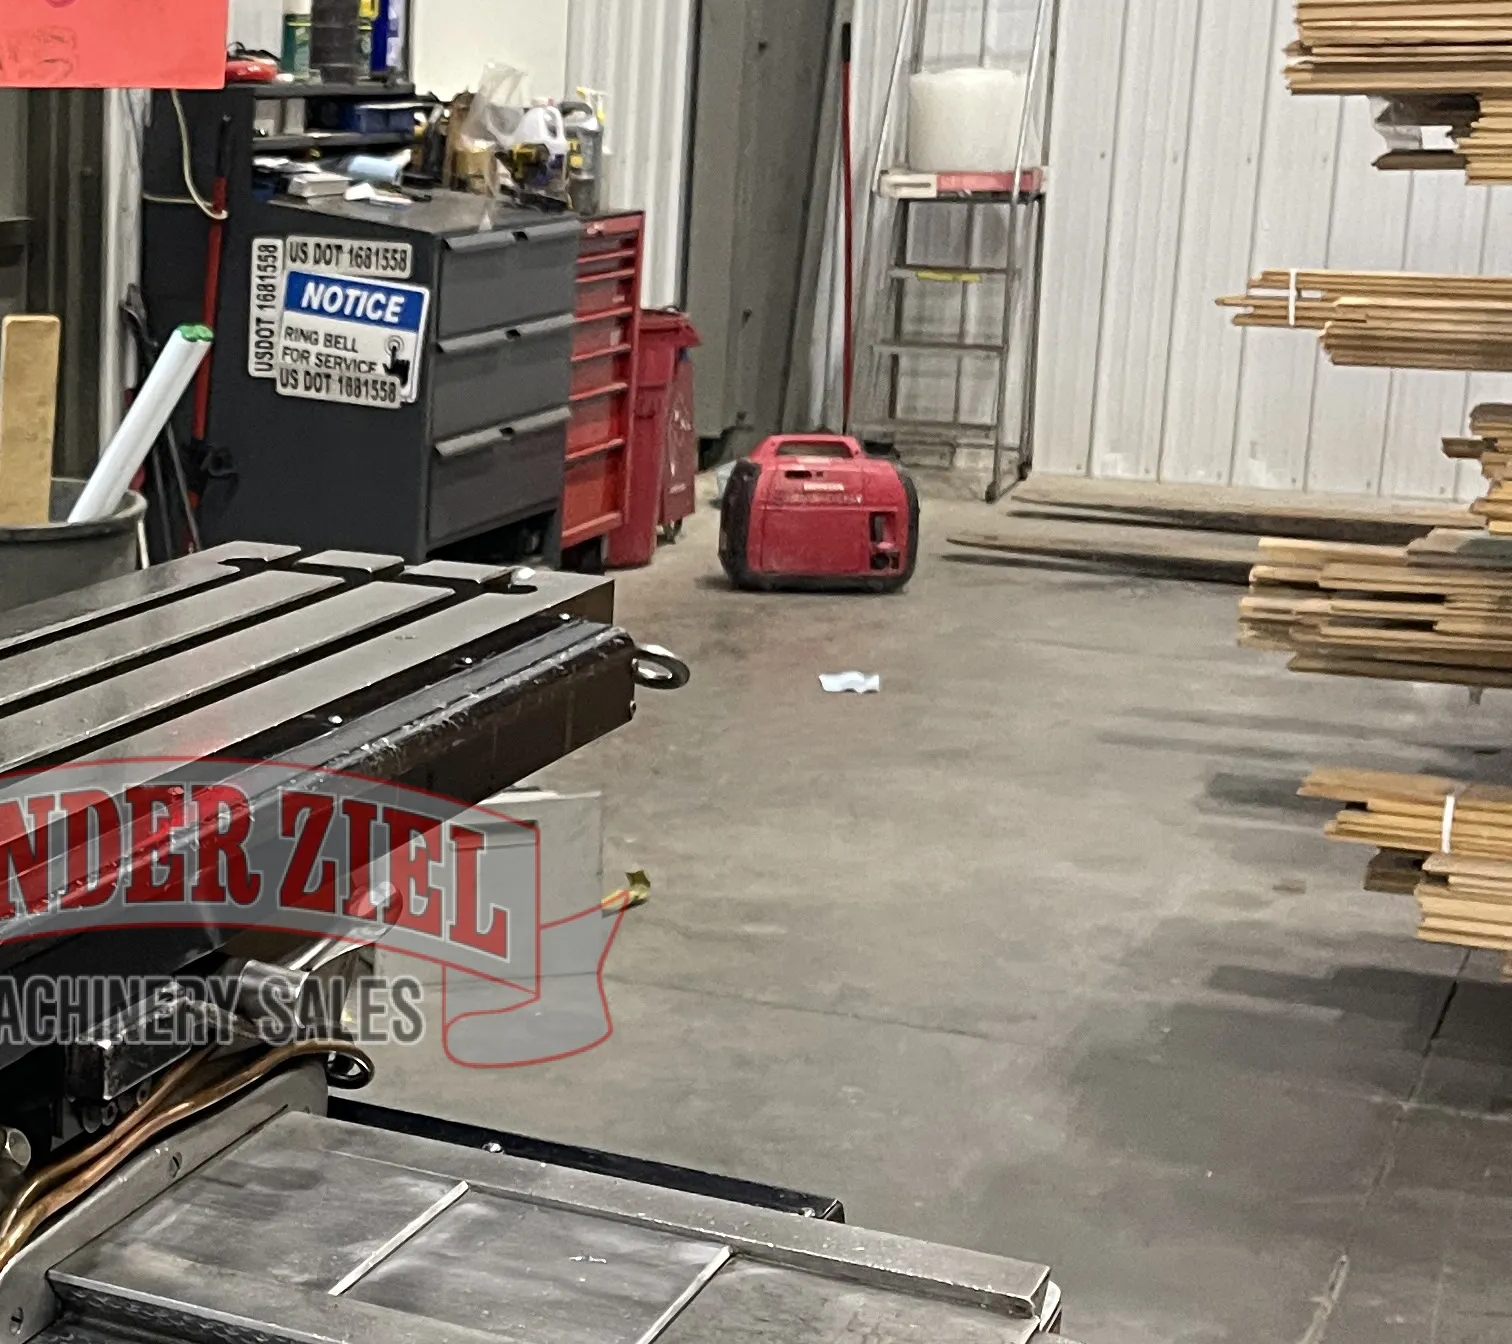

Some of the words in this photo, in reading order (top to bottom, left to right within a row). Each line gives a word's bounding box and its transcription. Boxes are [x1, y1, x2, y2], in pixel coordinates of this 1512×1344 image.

[290, 241, 308, 264] US
[313, 243, 343, 266] DOT
[348, 245, 408, 273] 1681558
[256, 244, 278, 312] 1681558
[300, 282, 406, 324] NOTICE
[284, 326, 319, 348] RING
[323, 333, 359, 354] BELL
[281, 346, 312, 365] FOR
[314, 352, 378, 374] SERVICE
[279, 369, 298, 390] US
[303, 372, 332, 394] DOT
